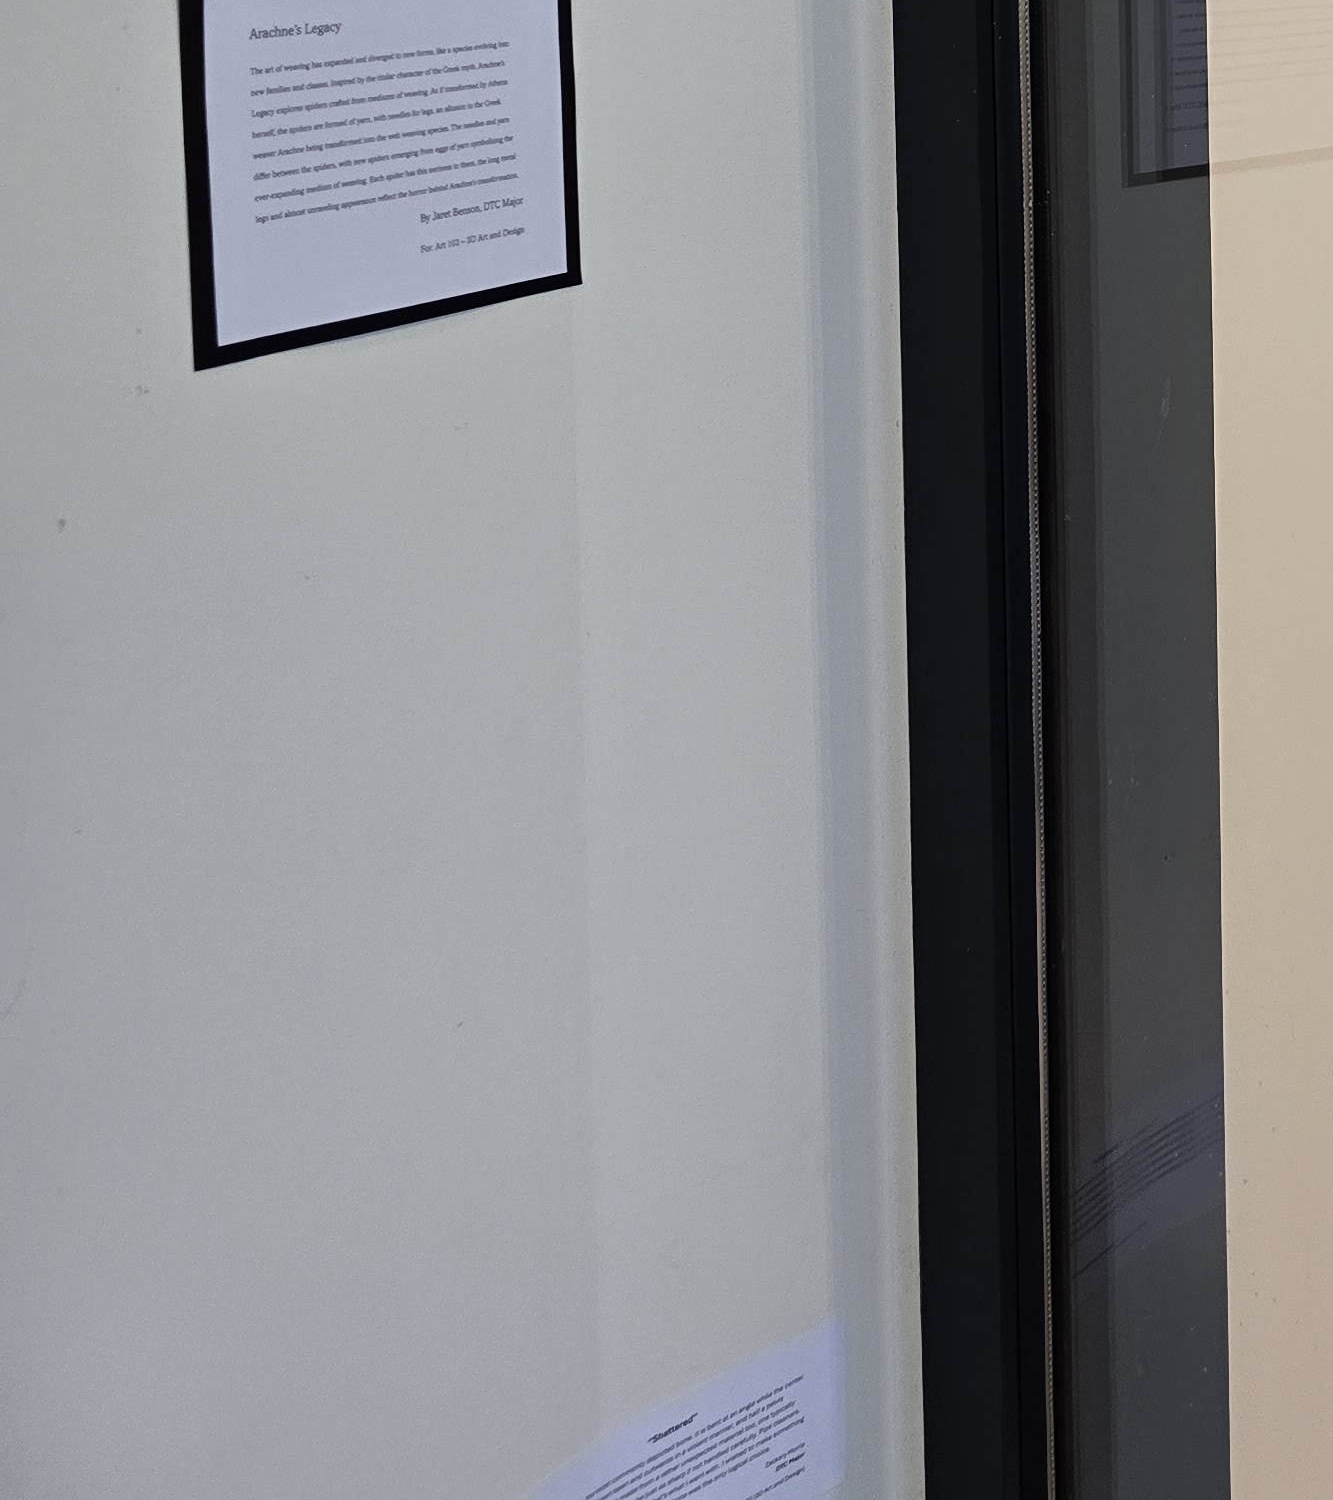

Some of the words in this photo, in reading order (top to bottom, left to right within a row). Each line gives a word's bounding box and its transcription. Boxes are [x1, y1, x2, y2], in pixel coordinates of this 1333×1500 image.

[249, 25, 302, 40] Arachne's
[304, 23, 342, 36] Legacy
[420, 214, 430, 224] By
[432, 211, 451, 220] Jaret
[452, 206, 482, 216] Benson,
[483, 200, 500, 211] DTC
[501, 198, 523, 207] Major
